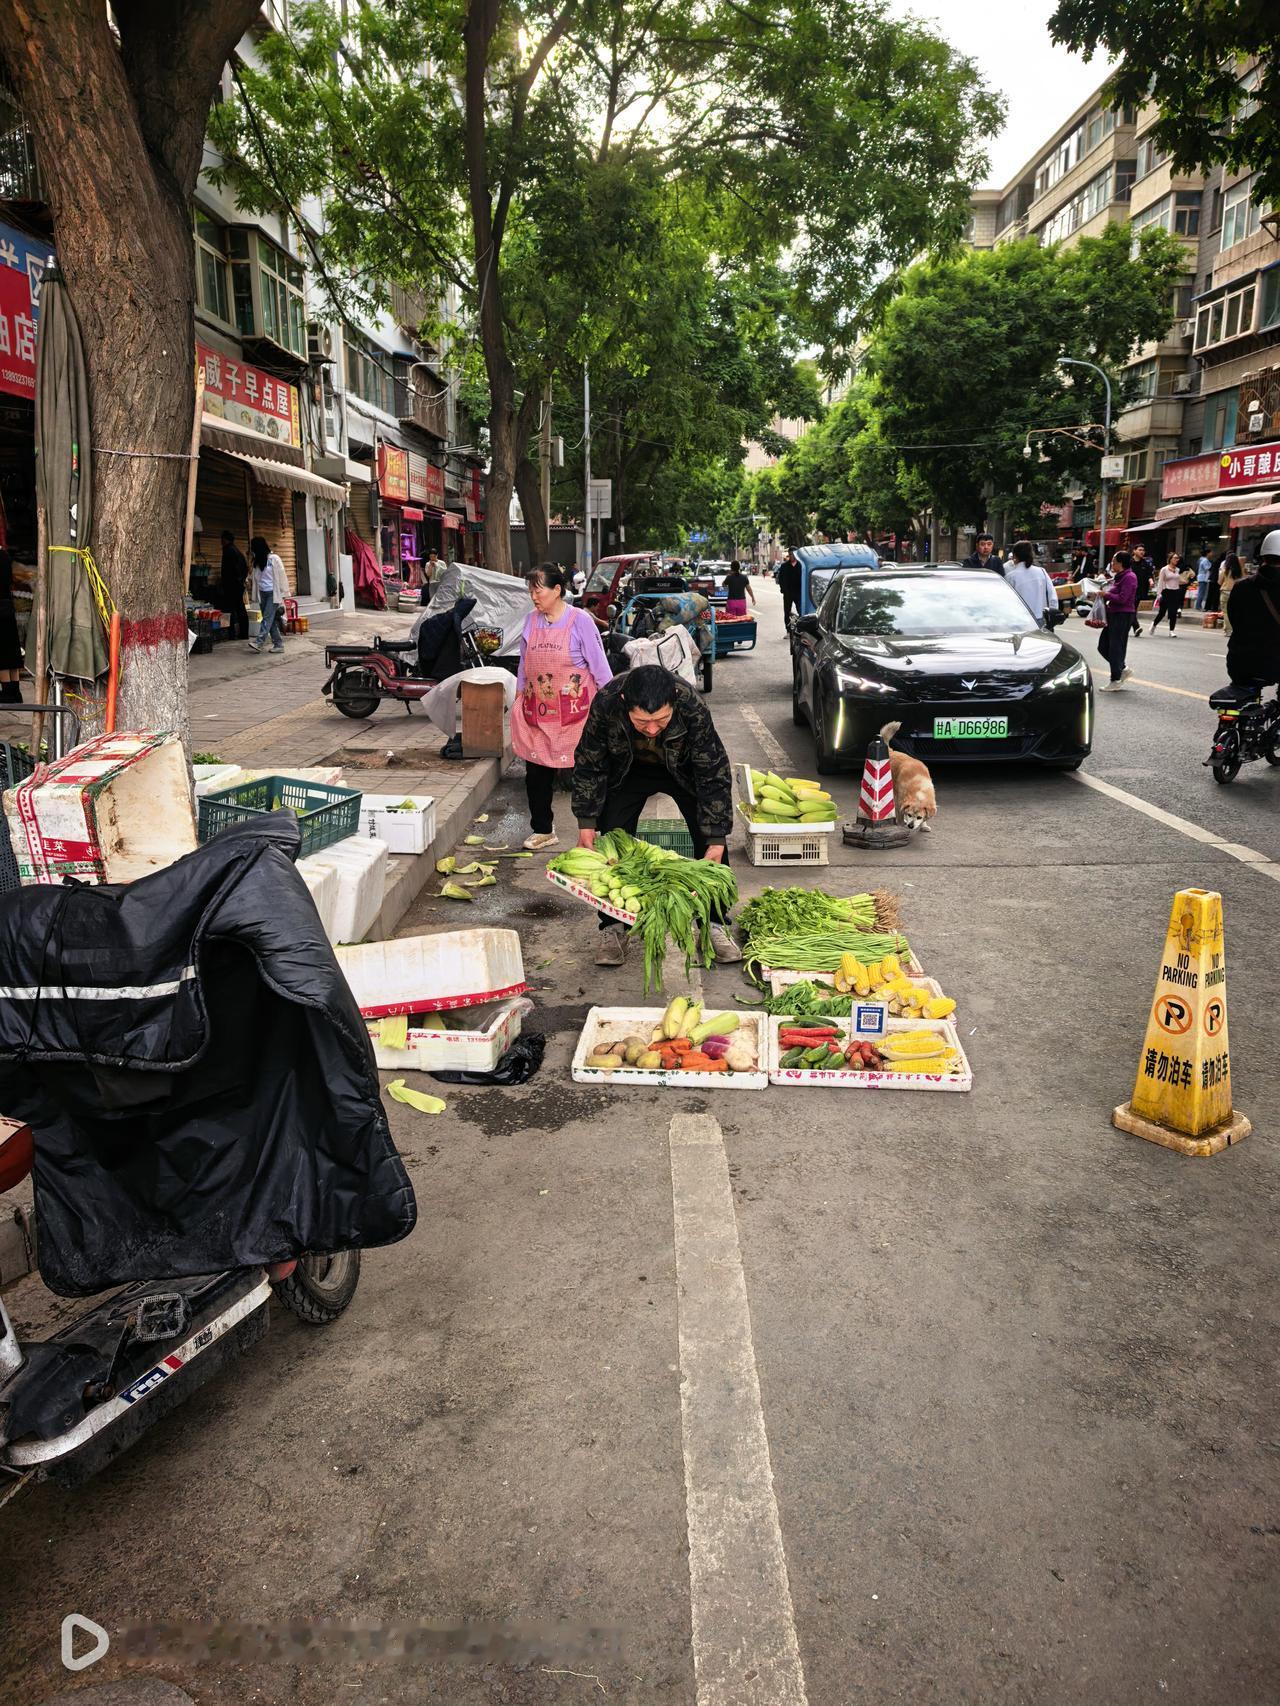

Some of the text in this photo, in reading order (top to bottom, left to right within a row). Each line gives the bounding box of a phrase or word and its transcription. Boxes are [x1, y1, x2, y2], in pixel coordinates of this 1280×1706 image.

[569, 699, 580, 714] K
[1177, 952, 1190, 970] NO
[1212, 952, 1220, 969] NO
[1162, 965, 1198, 989] PARKING
[1144, 1047, 1193, 1090] 请勿泊车
[1201, 1051, 1229, 1090] 请勿泊车
